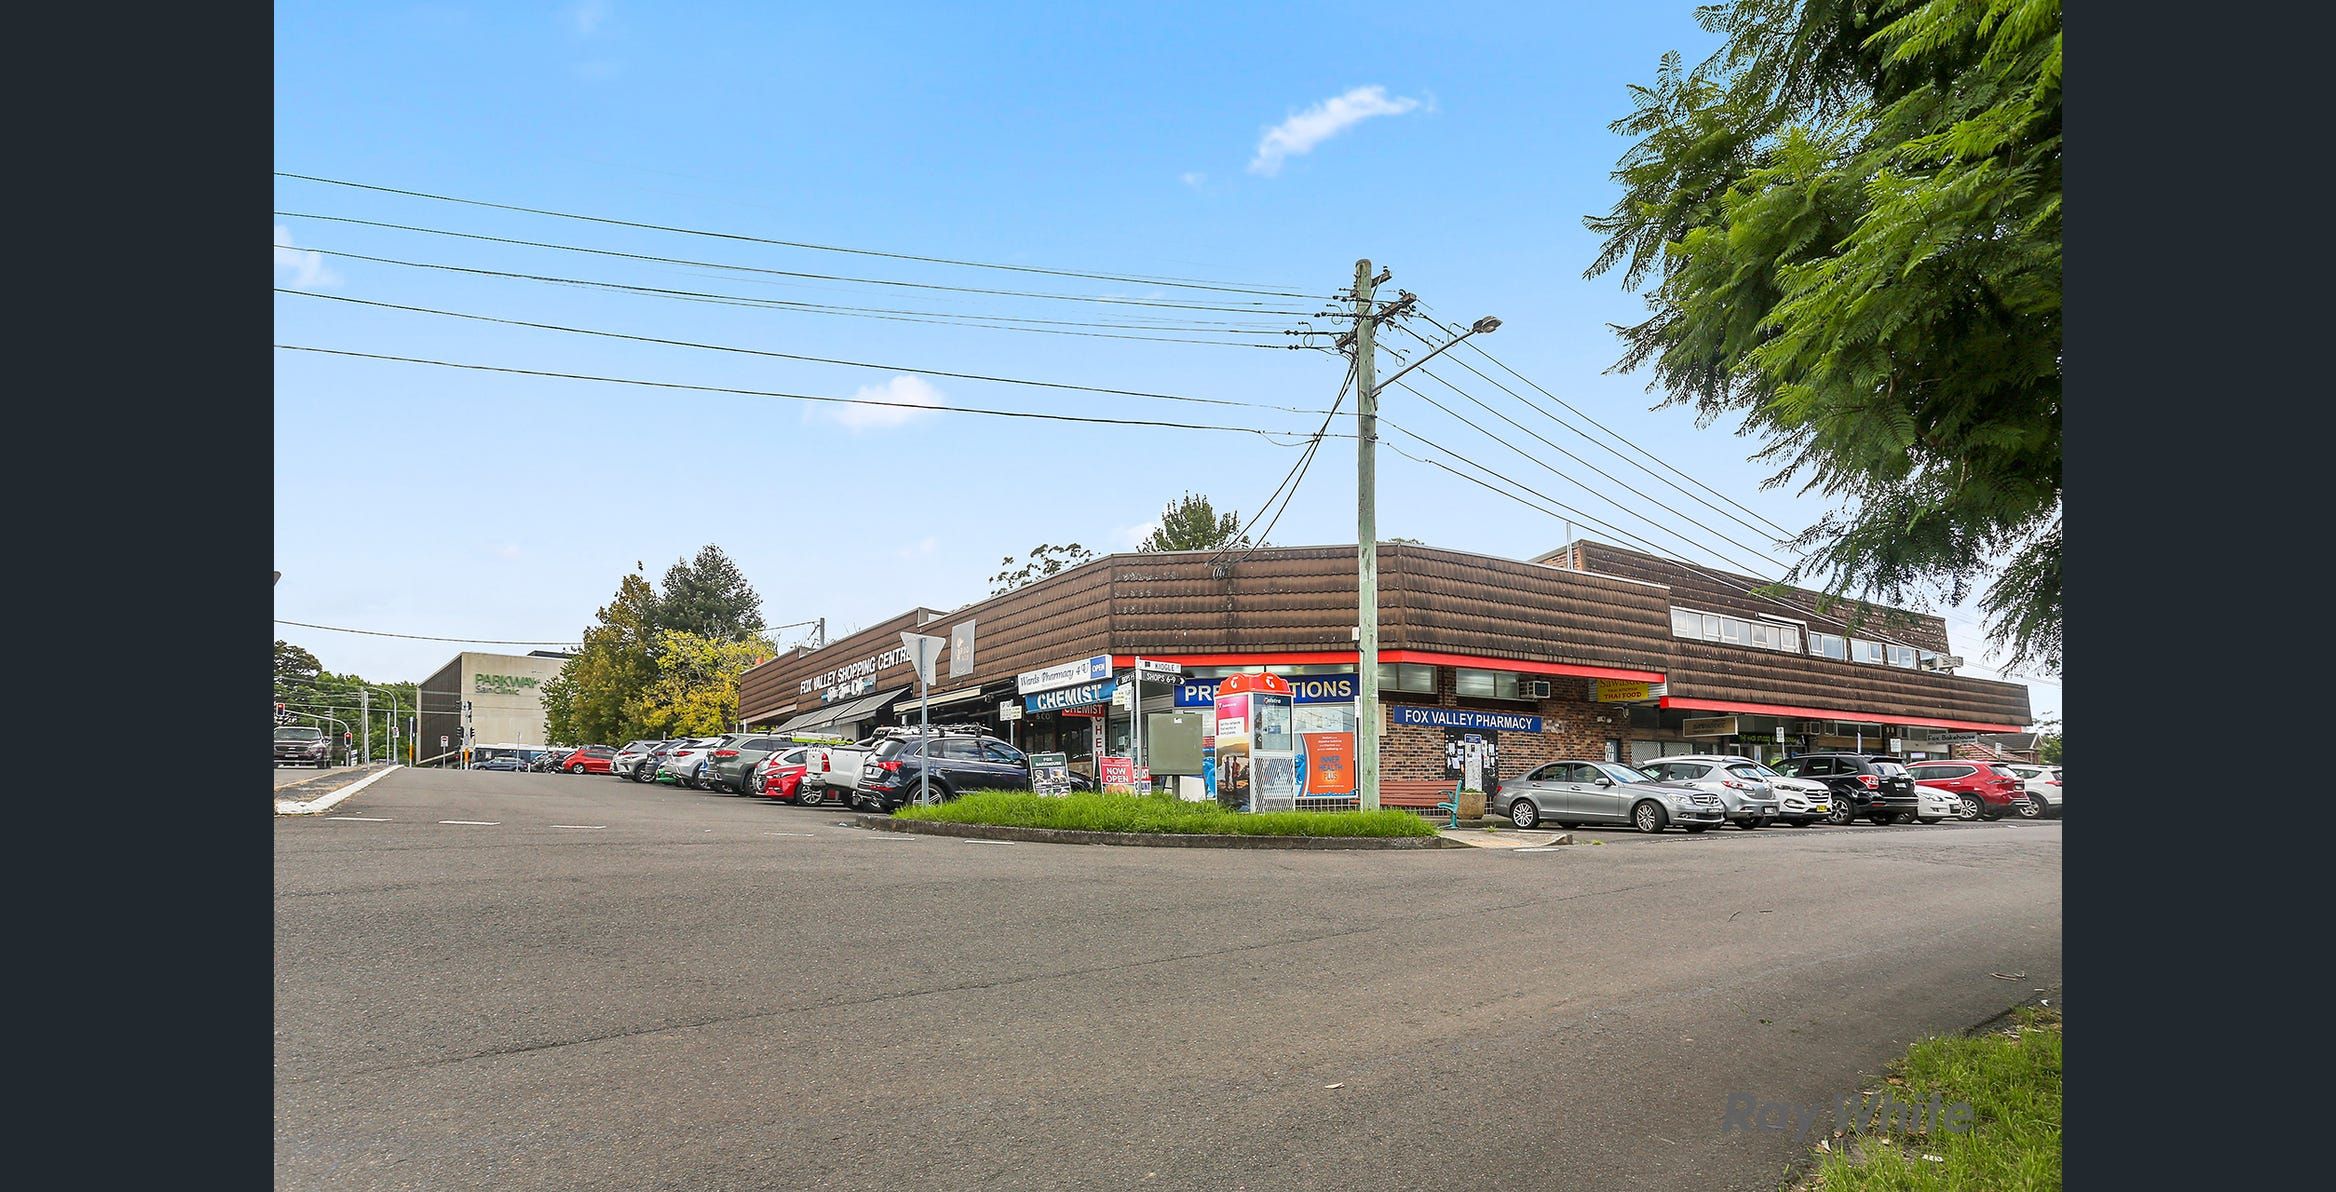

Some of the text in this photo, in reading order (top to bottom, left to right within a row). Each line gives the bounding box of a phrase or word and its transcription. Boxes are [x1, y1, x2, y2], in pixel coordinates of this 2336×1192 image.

[1092, 662, 1106, 673] OPEN
[475, 673, 535, 689] PARKWAY
[800, 679, 811, 695] FOX
[814, 670, 839, 692] VALLEY
[837, 656, 876, 681] SHOPPING
[1020, 674, 1040, 687] Wards
[1041, 669, 1074, 683] Pharmacy
[1146, 672, 1165, 683] SHOPS
[1166, 675, 1177, 684] 6-9
[1037, 684, 1103, 710] CHEMIST
[1622, 691, 1641, 699] FOOD
[1064, 704, 1103, 715] CHEMIST
[1405, 709, 1533, 730] FOX VALLEY PHARMACY
[1942, 732, 1975, 741] Bakehouse
[1106, 767, 1126, 775] NOW
[1324, 772, 1338, 781] PLUS
[1106, 775, 1129, 783] OPEN
